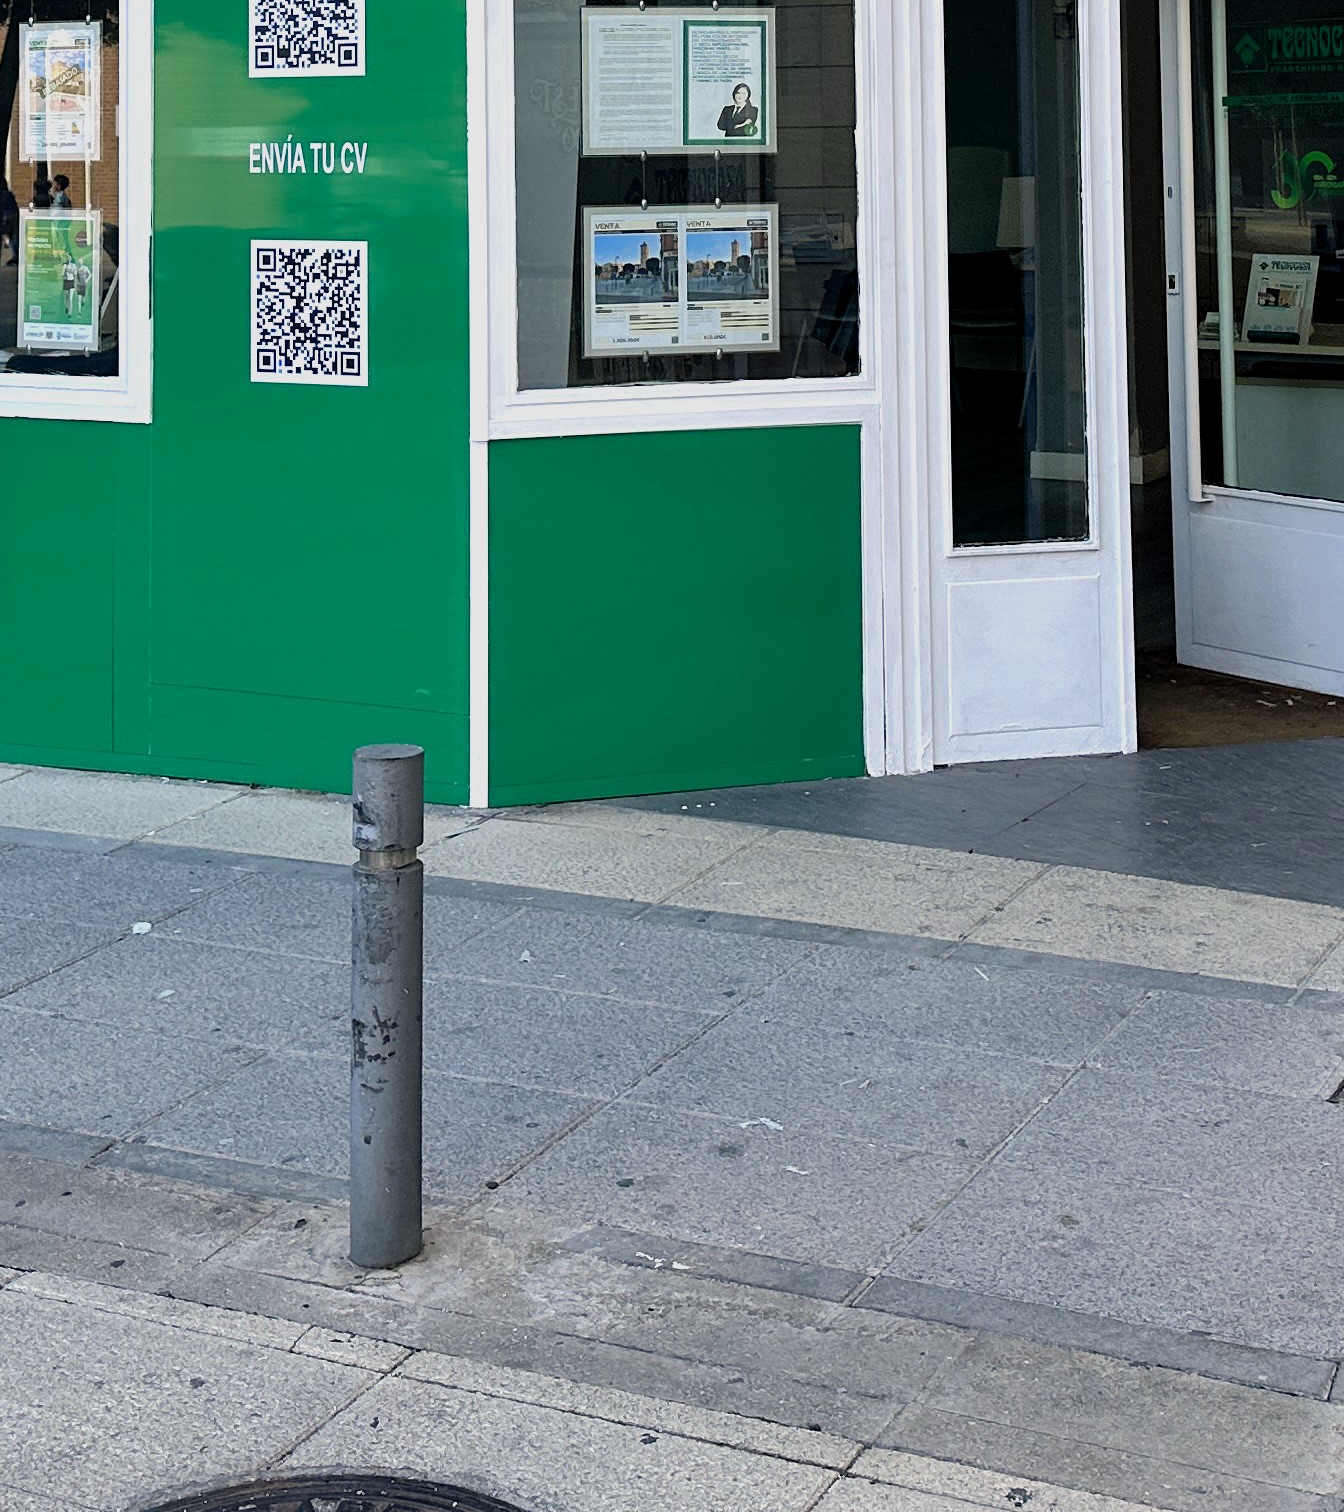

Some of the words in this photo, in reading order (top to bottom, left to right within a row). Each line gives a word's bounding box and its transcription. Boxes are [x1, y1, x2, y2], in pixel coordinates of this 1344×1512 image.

[43, 66, 79, 95] EBAJADO
[249, 134, 306, 174] ENVÍA
[309, 142, 336, 174] TU
[341, 142, 368, 174] CV
